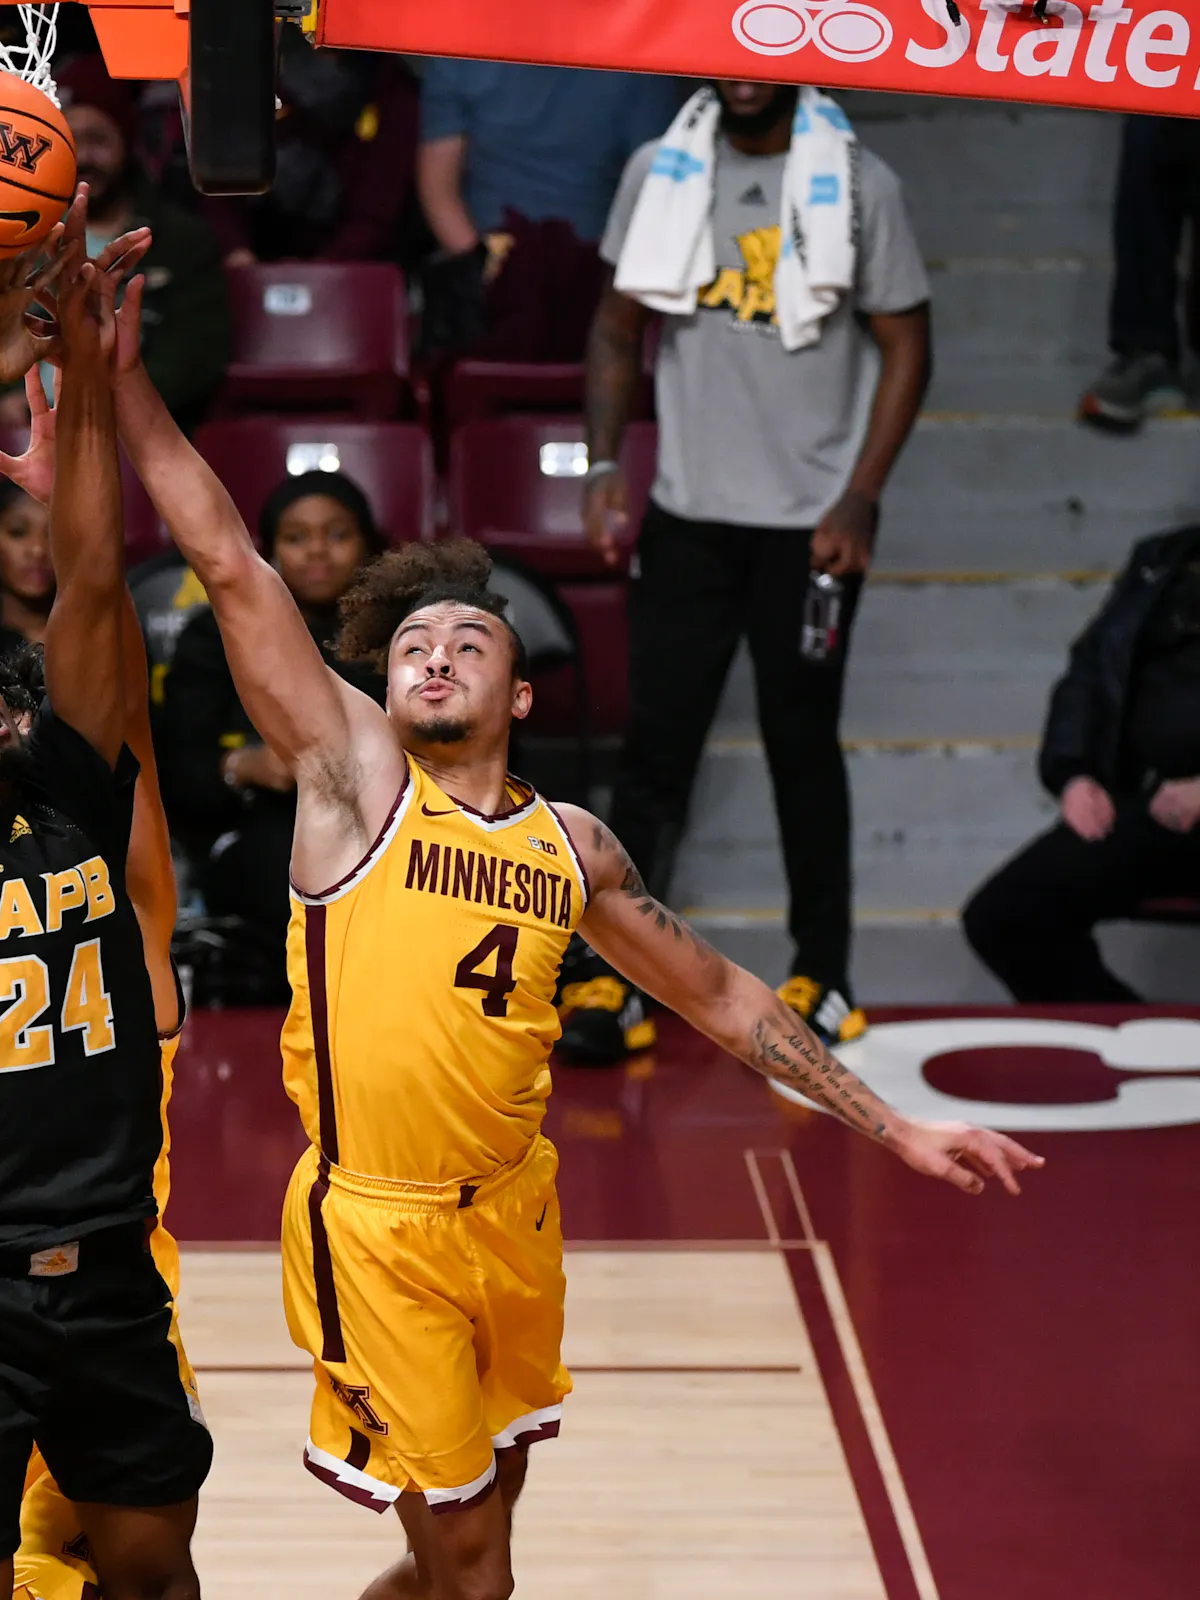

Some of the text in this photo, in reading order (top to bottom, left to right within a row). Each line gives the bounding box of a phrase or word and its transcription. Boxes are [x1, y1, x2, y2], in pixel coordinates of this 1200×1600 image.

[905, 0, 1190, 88] State
[405, 839, 571, 929] MINNESOTA
[454, 923, 519, 1017] 4
